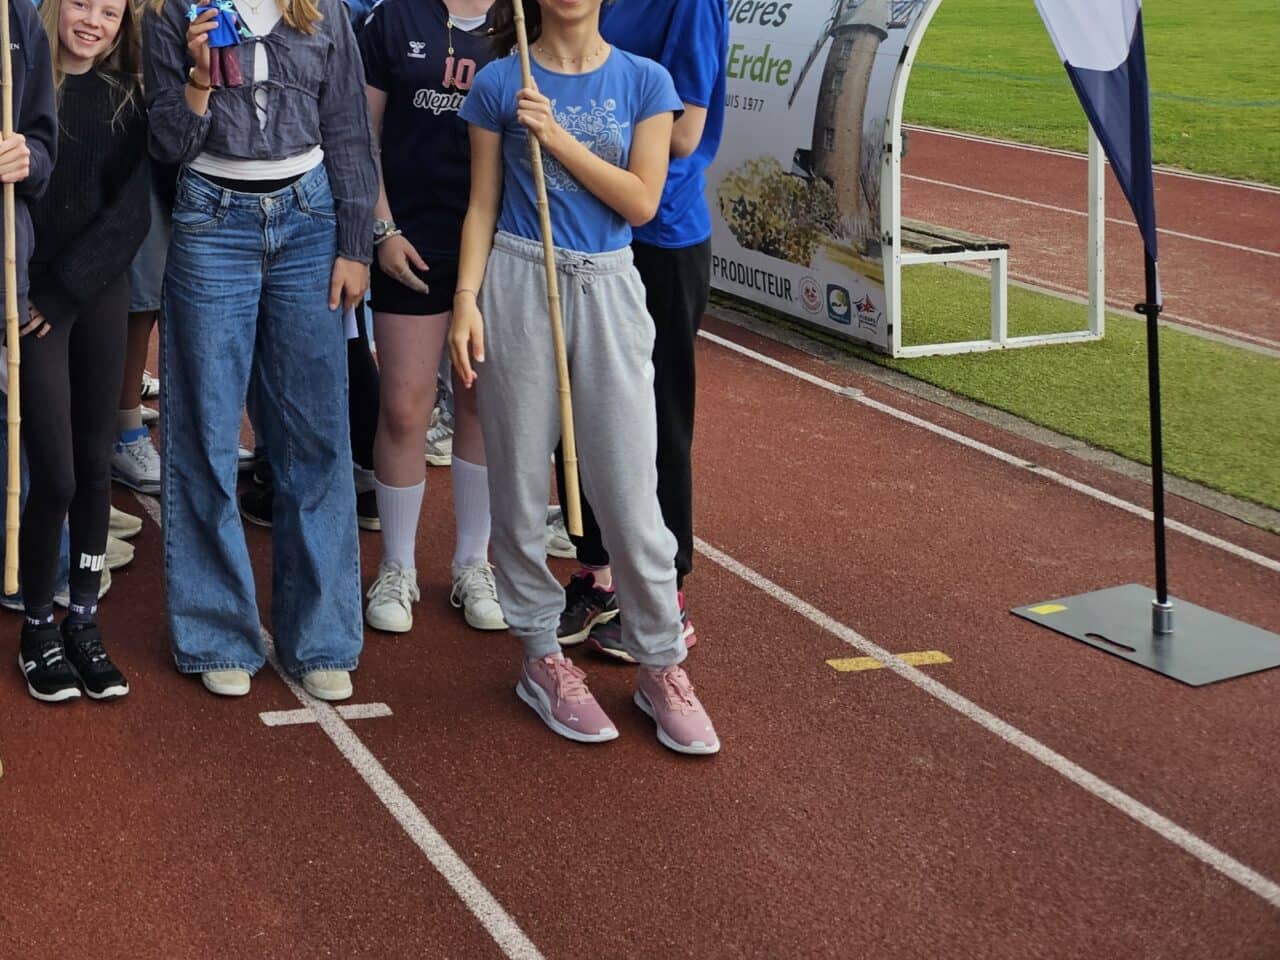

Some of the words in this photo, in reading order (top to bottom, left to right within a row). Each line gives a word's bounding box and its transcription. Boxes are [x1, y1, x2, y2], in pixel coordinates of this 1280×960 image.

[442, 56, 477, 91] 10
[742, 96, 765, 113] 1977
[712, 255, 793, 302] PRODUCTEUR
